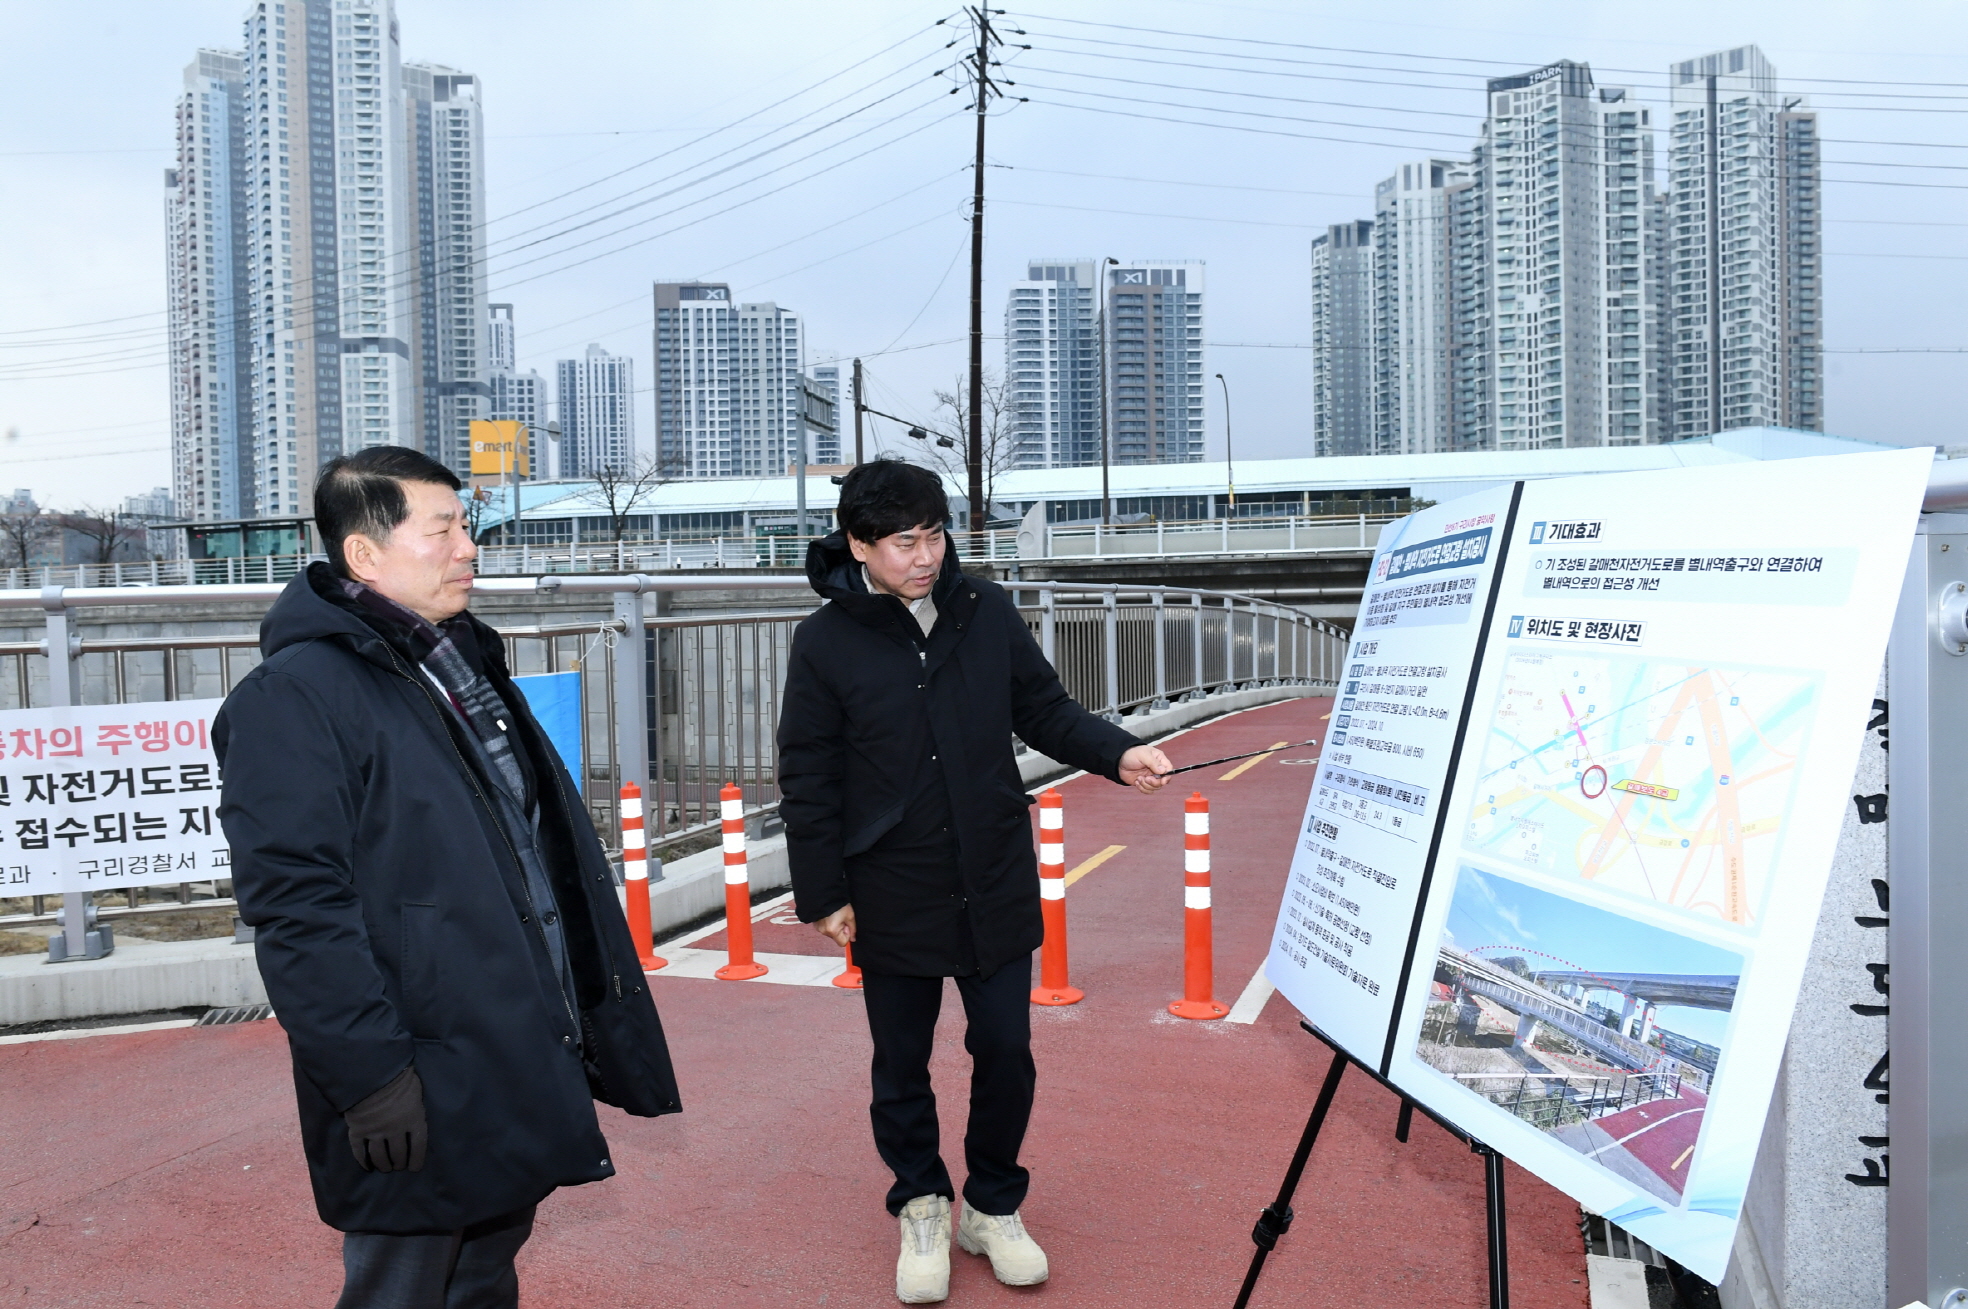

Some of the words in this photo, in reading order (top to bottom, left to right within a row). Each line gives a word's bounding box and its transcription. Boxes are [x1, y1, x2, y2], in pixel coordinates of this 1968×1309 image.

[474, 441, 513, 453] emart
[1548, 522, 1602, 540] 기대효과
[1545, 558, 1556, 571] 기
[1557, 558, 1587, 571] 조성된
[1588, 557, 1686, 571] 갈매천자전거도로를
[1688, 557, 1764, 572] 별내역출구와
[1766, 557, 1823, 572] 연결하여
[1458, 577, 1476, 591] 자전거
[1542, 576, 1602, 590] 별내역으로의
[1602, 577, 1635, 590] 접근성
[1637, 577, 1660, 591] 개선
[1527, 618, 1564, 637] 위치도
[1567, 621, 1582, 639] 및
[1584, 621, 1642, 642] 현장사진
[0, 726, 83, 761] 차의
[97, 719, 207, 756] 주행이
[23, 762, 223, 805] 자전거도로
[16, 811, 167, 850] 접수되는
[180, 806, 222, 837] 지
[0, 864, 31, 885] 과
[79, 852, 196, 880] 구리경찰서
